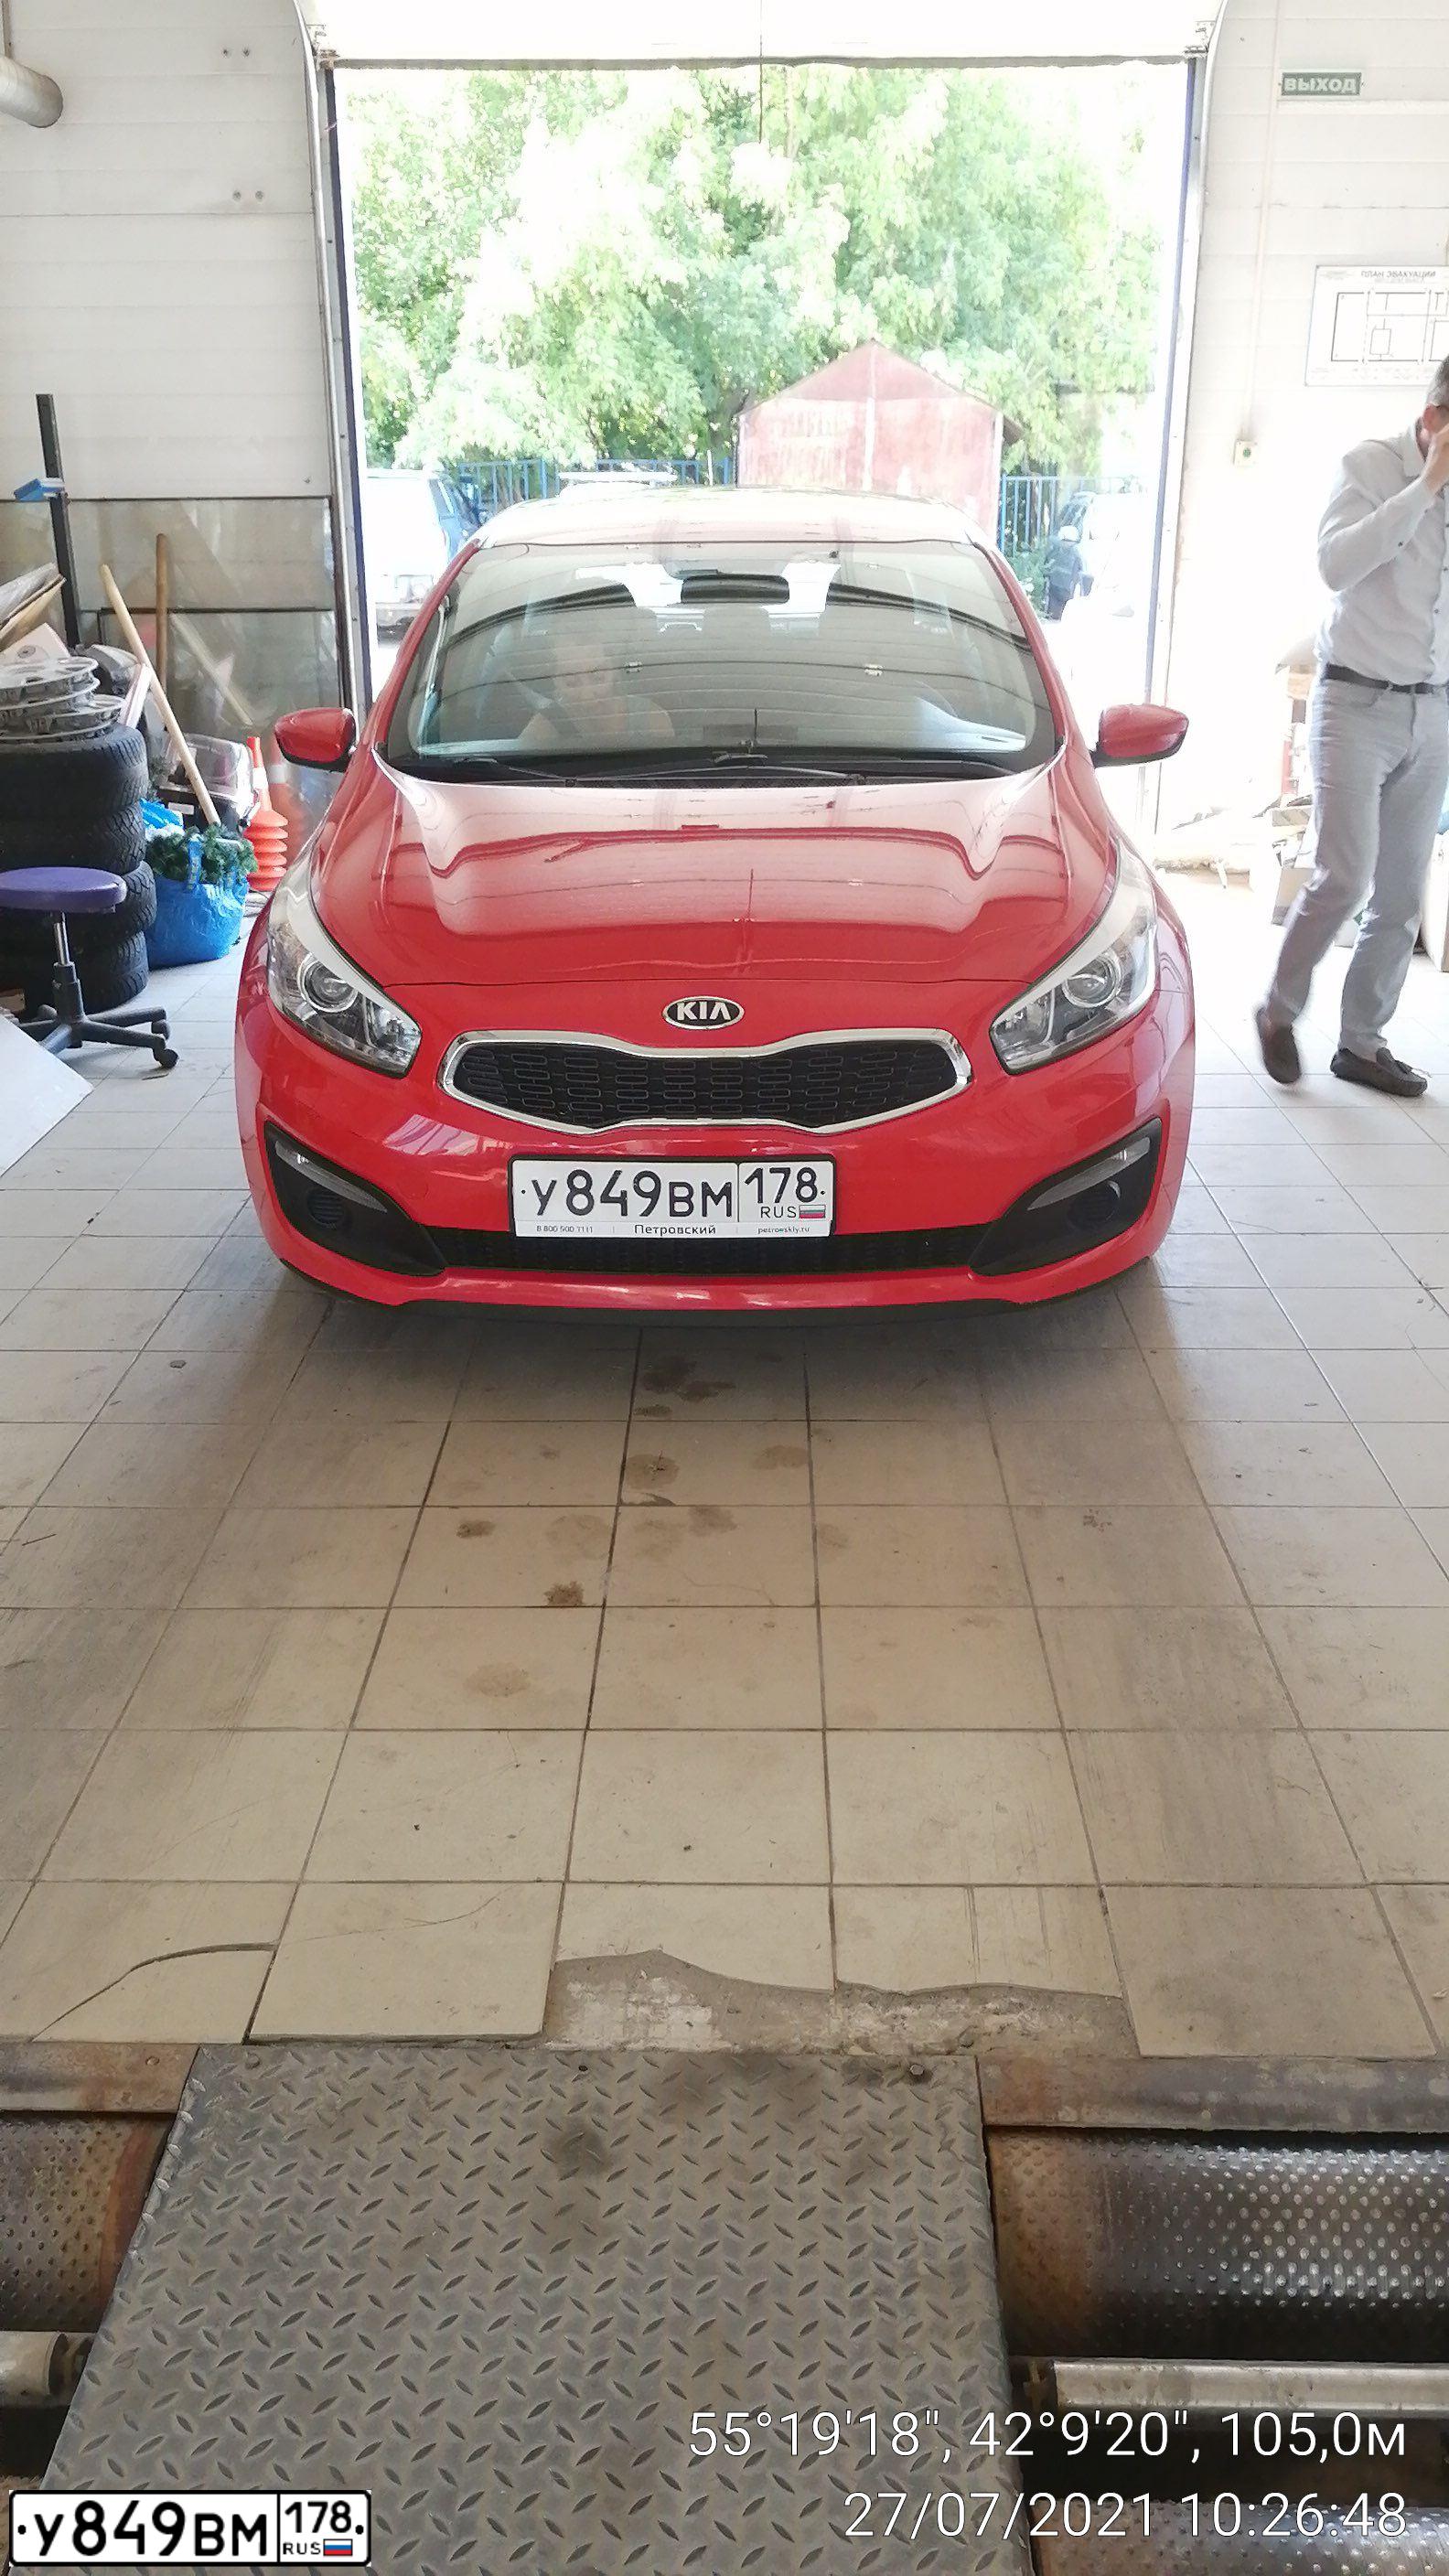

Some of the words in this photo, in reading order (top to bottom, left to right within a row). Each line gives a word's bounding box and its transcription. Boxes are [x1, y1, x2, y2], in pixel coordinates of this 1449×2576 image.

[1283, 77, 1357, 93] ВЫХОД
[1360, 270, 1385, 278] ПЛАН
[677, 1001, 732, 1021] KIA
[744, 1166, 818, 1204] 178
[760, 1206, 798, 1218] RUS
[634, 1224, 716, 1236] Петровский
